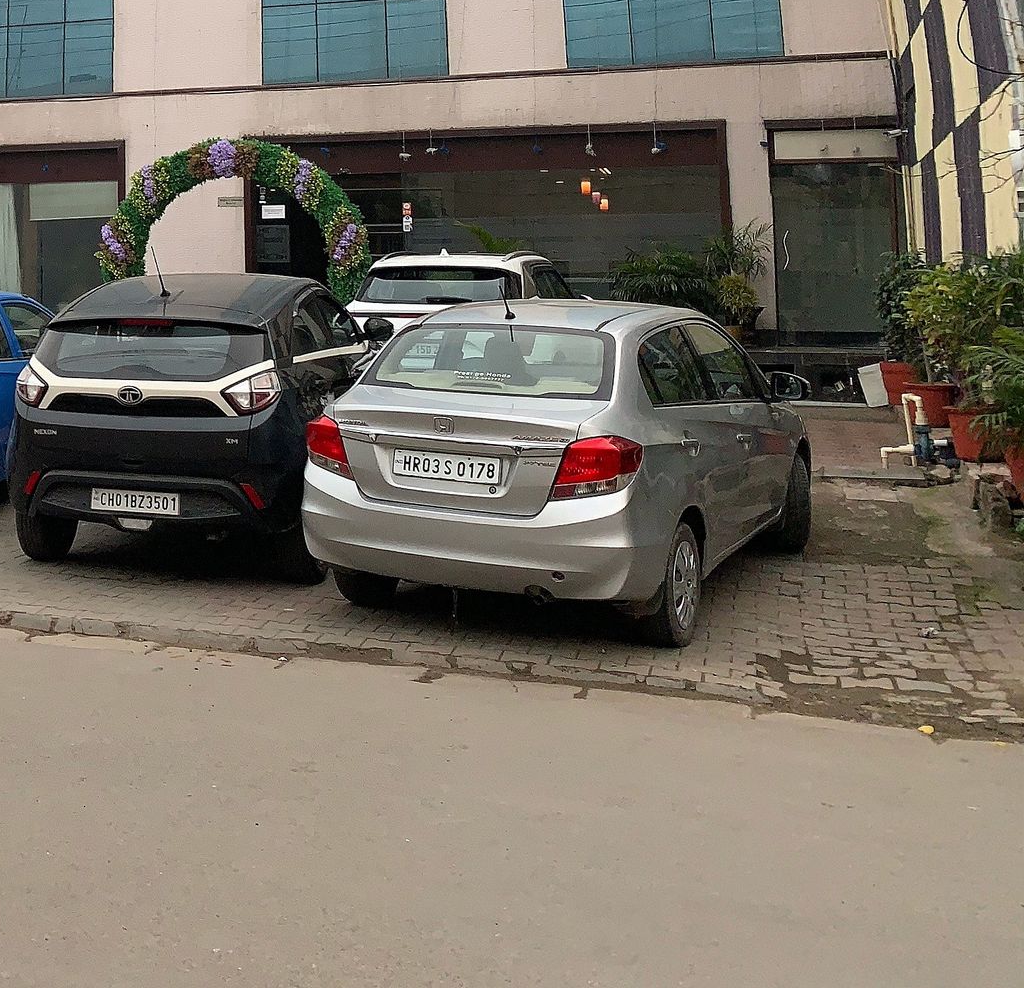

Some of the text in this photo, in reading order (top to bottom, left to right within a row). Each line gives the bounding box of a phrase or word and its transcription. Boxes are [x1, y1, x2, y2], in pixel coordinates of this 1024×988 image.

[225, 437, 239, 445] XM
[403, 455, 495, 479] HR03 S 0178
[100, 492, 176, 511] CH01BZ3501
